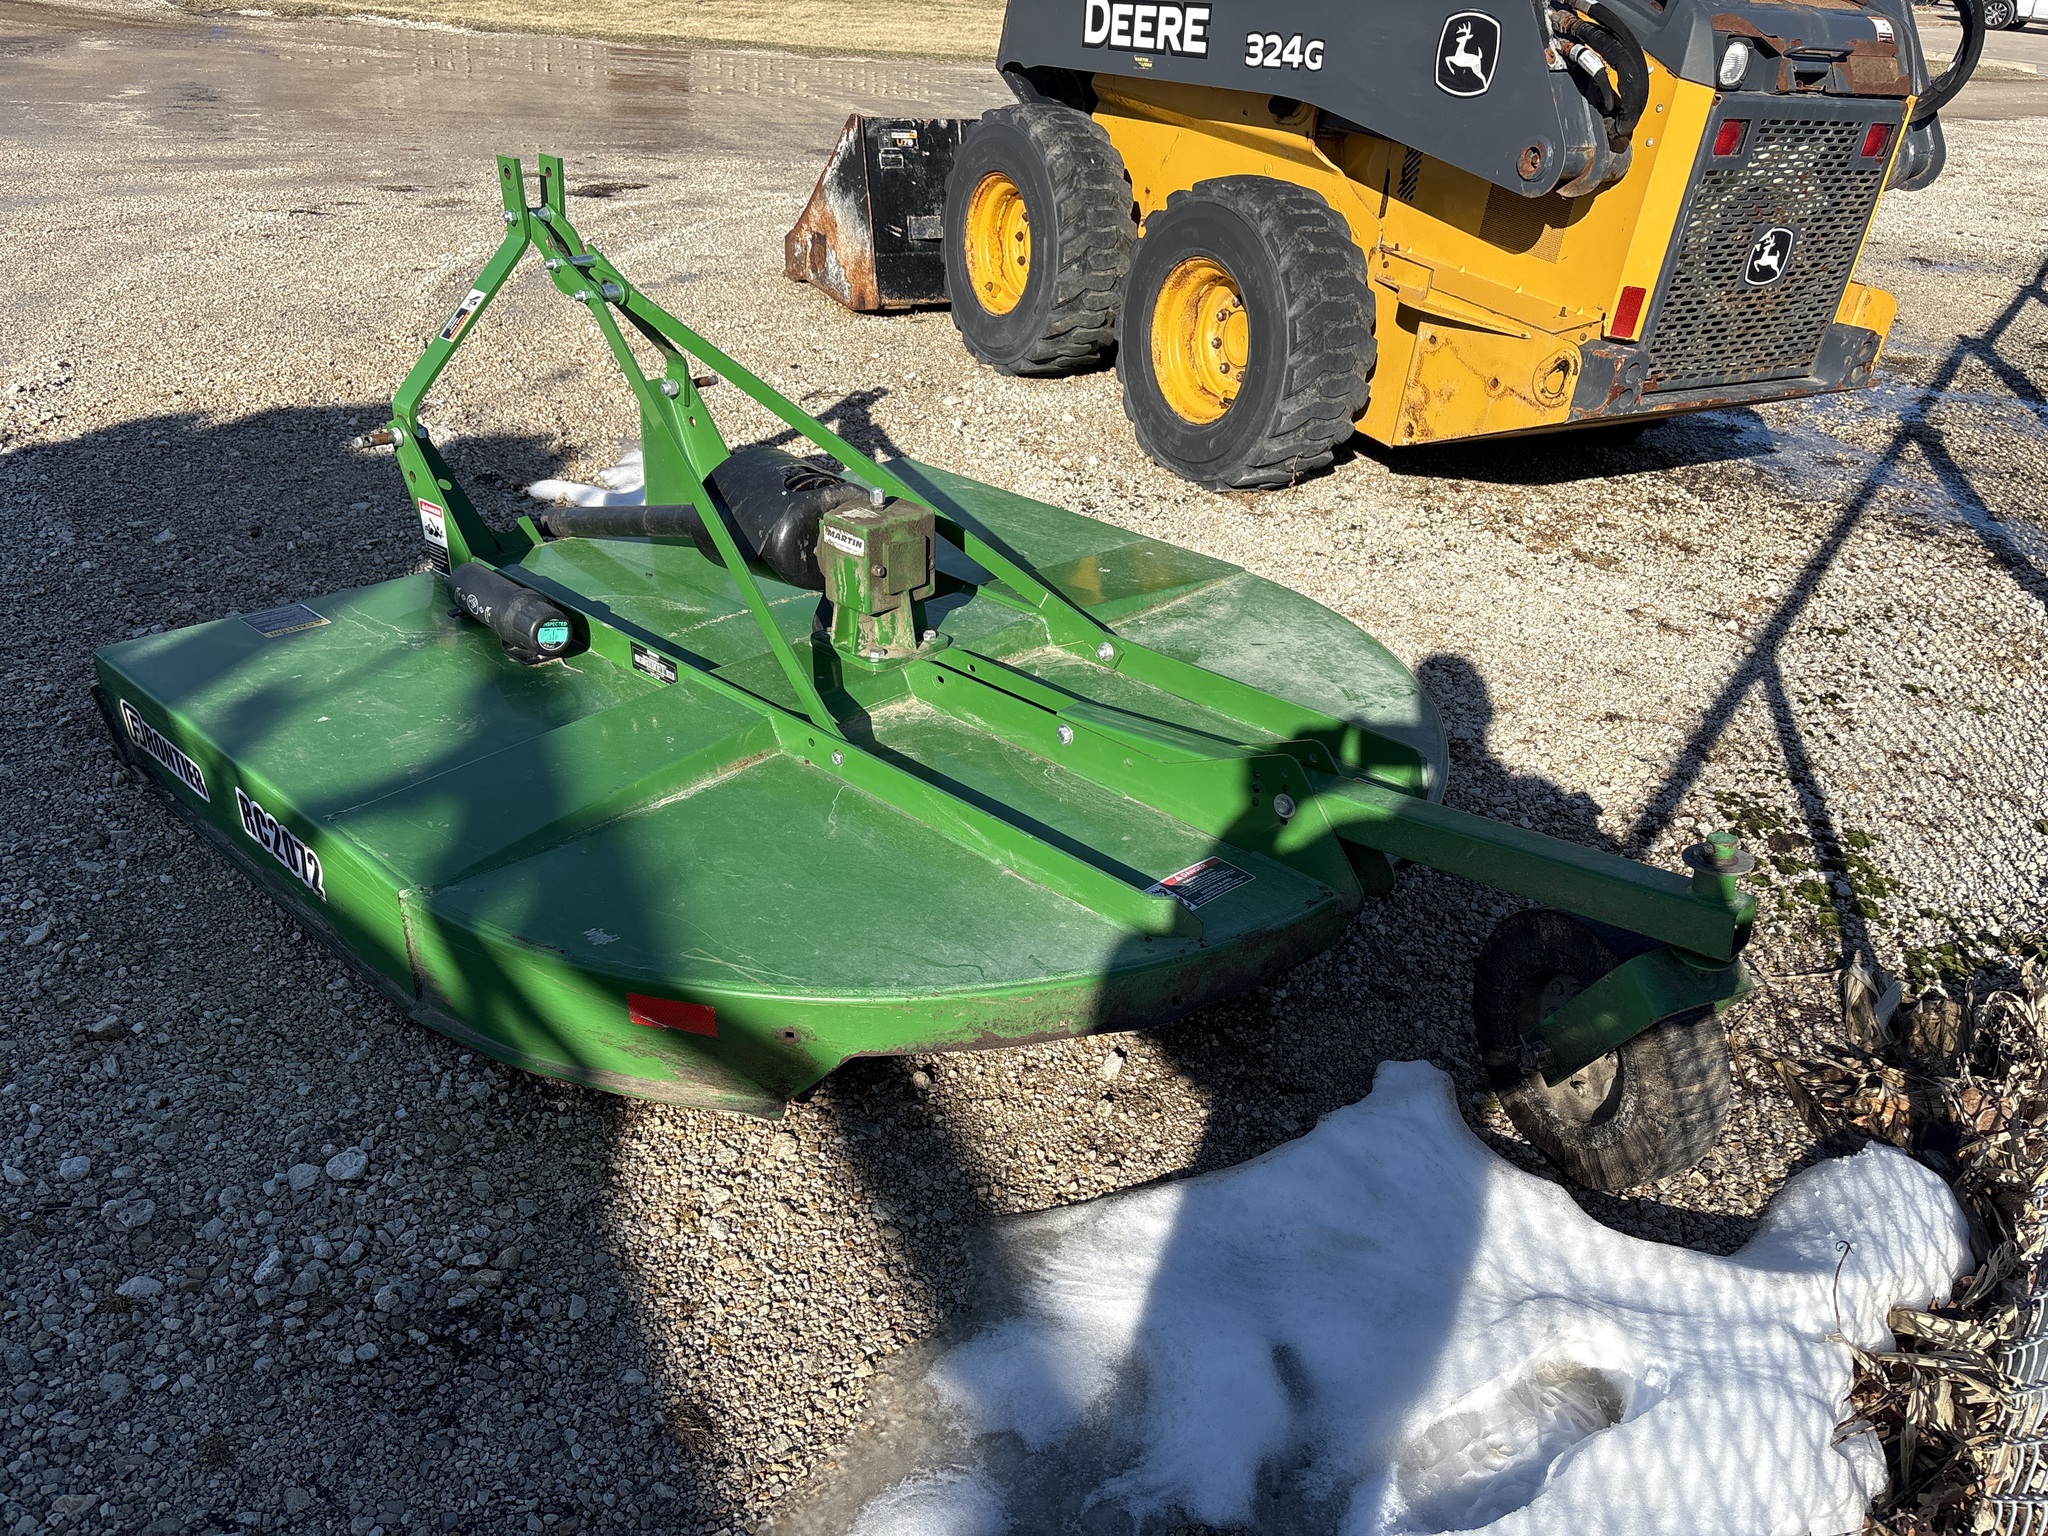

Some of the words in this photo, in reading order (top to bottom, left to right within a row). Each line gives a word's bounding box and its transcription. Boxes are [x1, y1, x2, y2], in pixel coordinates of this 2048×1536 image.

[1083, 0, 1210, 54] DEERE
[1244, 32, 1325, 71] 324G
[827, 529, 863, 549] MARTIN
[121, 700, 209, 801] FRONTIER
[236, 789, 326, 899] RC2072
[1181, 863, 1209, 878] DANGER
